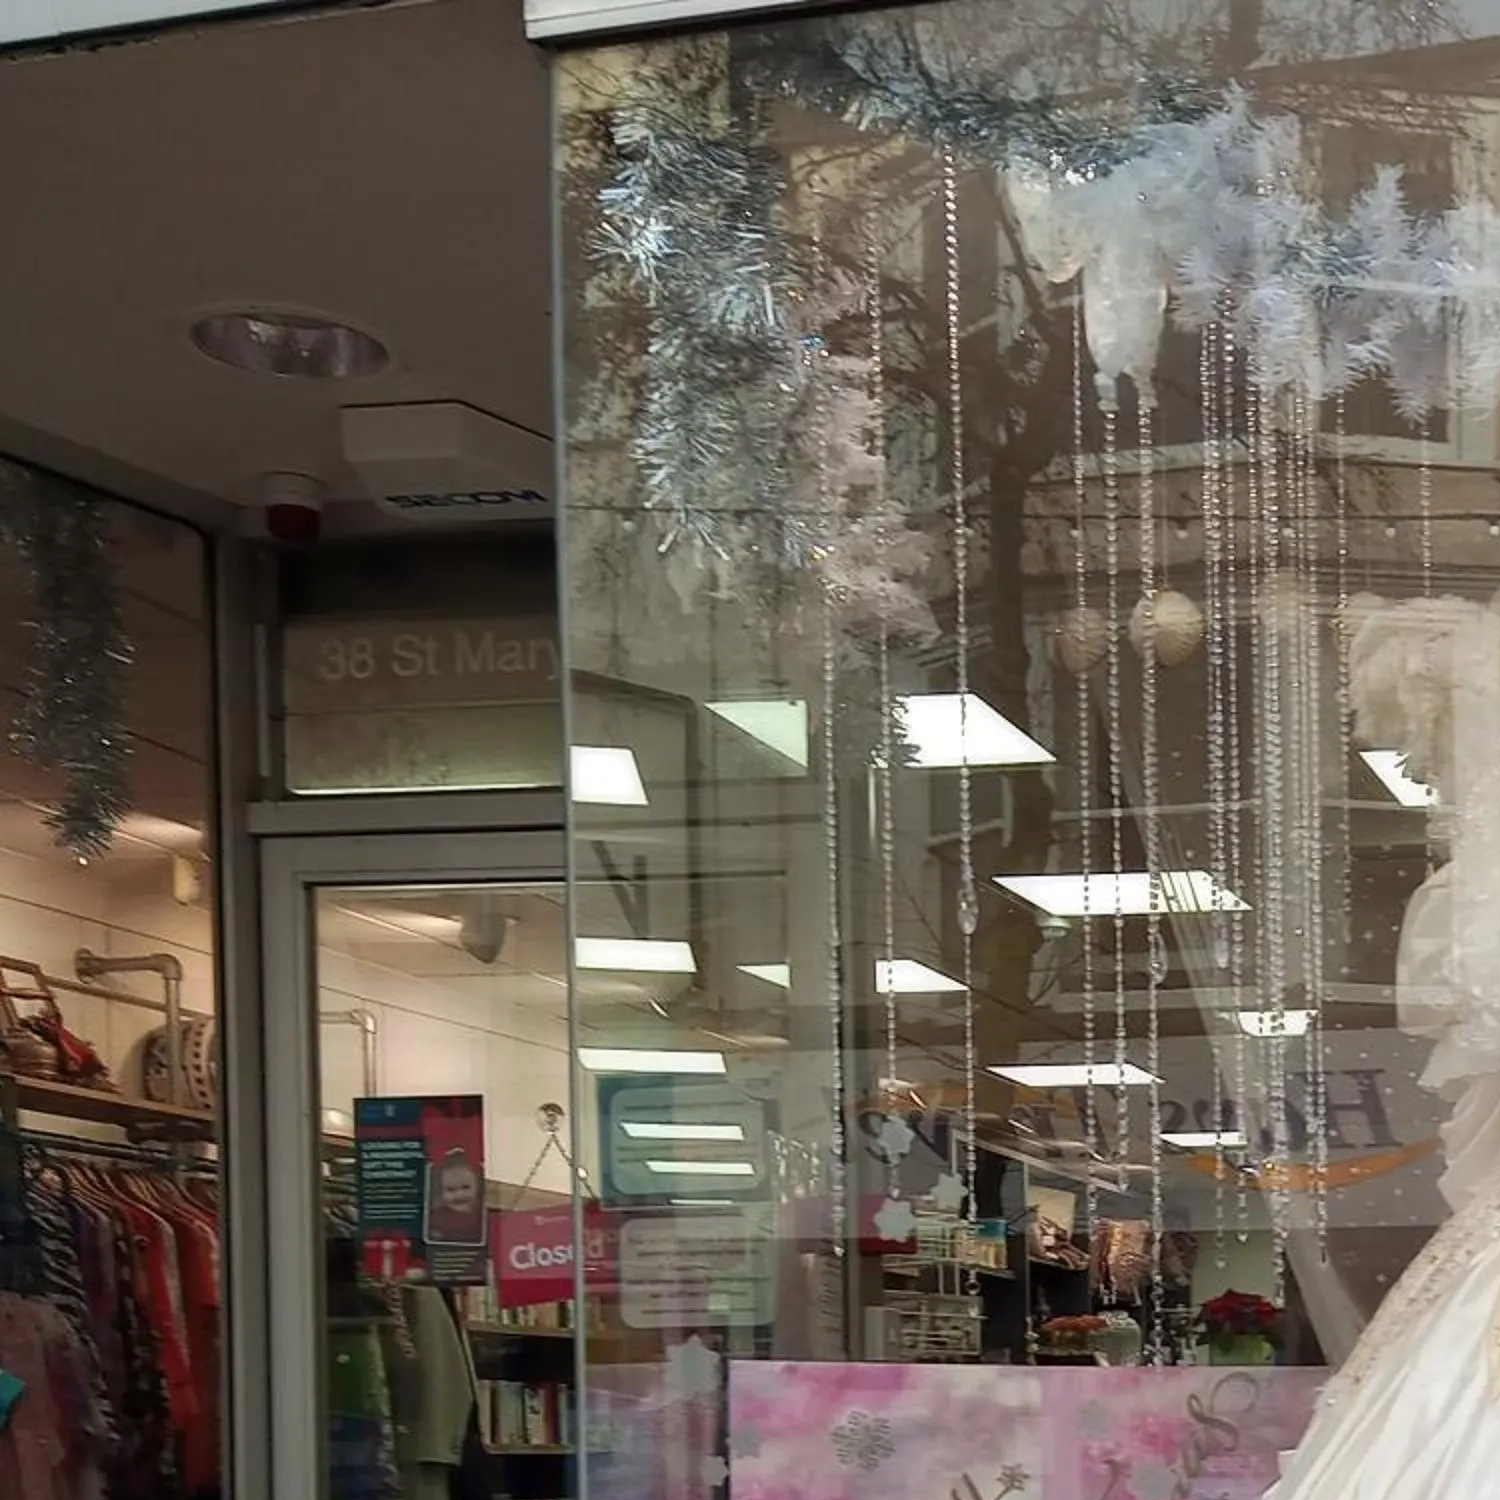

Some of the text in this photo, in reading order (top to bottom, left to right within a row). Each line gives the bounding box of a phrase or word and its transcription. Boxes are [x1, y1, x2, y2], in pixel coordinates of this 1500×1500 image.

[385, 489, 549, 508] SECOM
[320, 637, 375, 681] 38
[390, 633, 440, 678] St
